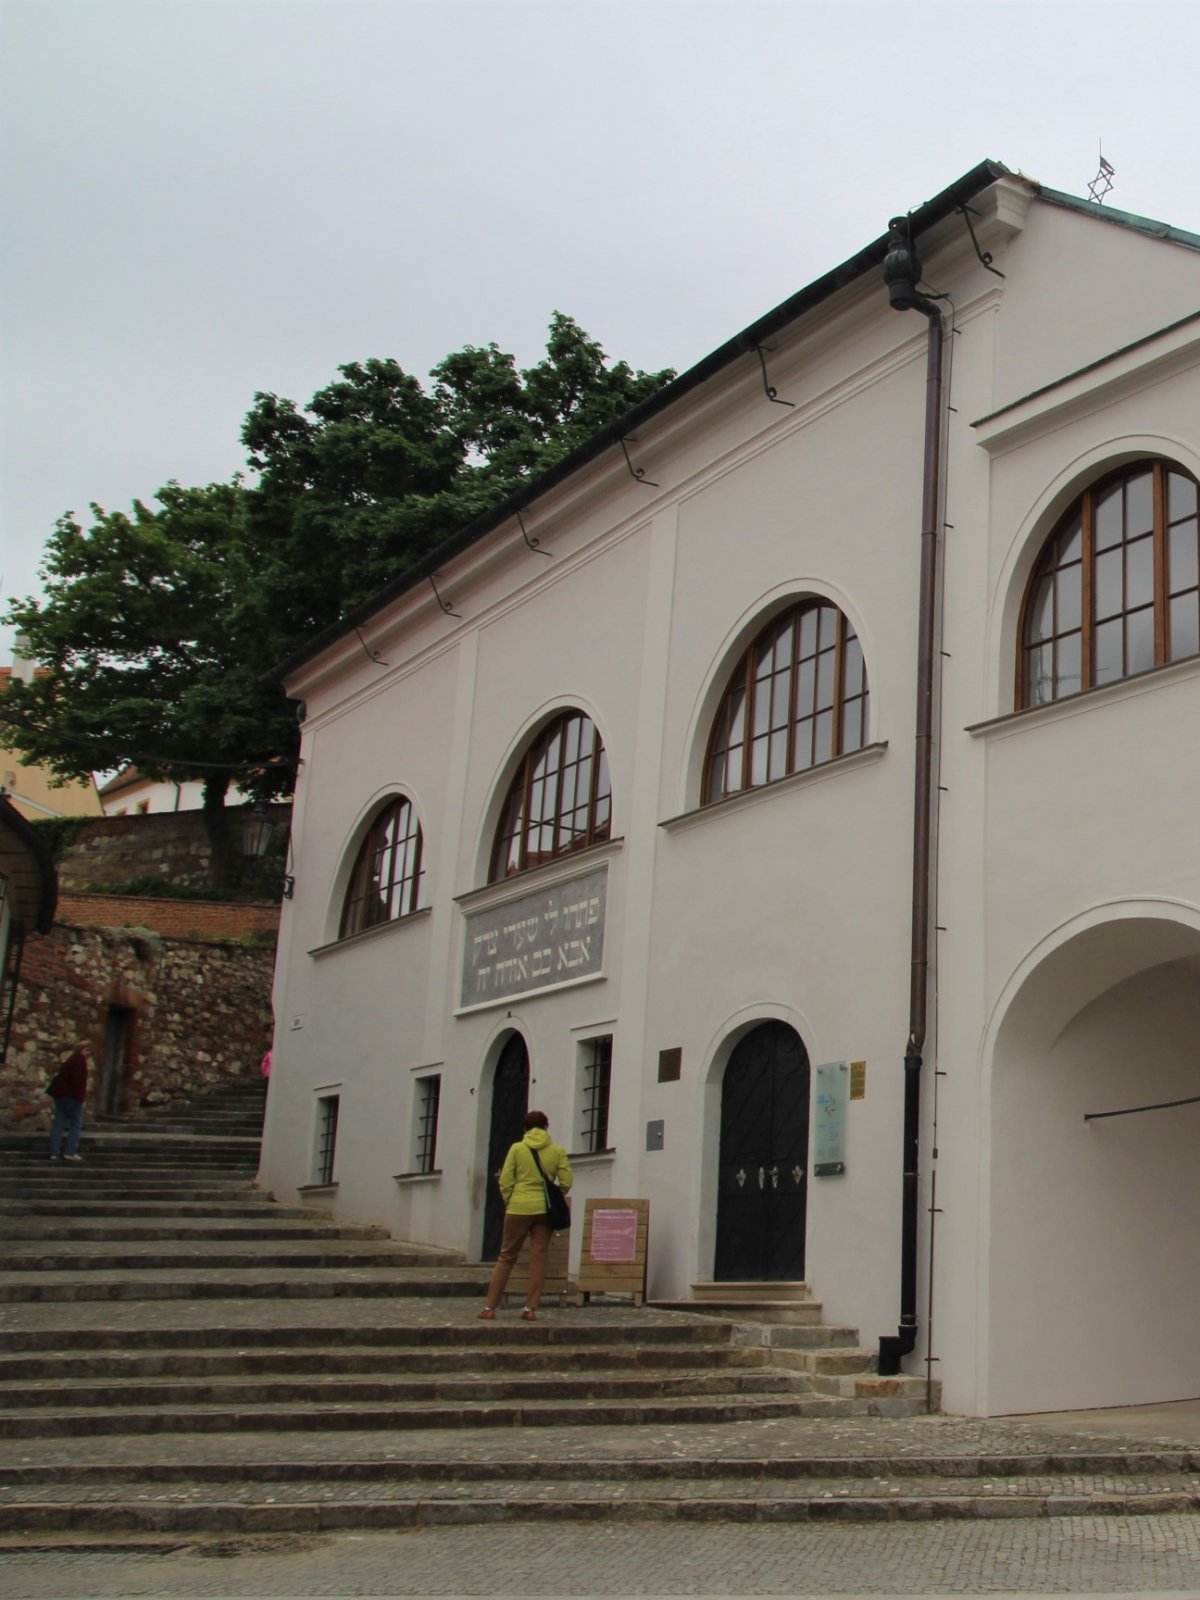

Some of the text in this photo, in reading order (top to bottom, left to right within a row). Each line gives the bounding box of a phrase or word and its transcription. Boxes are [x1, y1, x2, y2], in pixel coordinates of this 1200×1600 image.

[472, 897, 600, 967] פתחו לי שערי צדק
[531, 948, 552, 977] בם
[557, 936, 592, 970] אבא
[477, 966, 491, 992] יה
